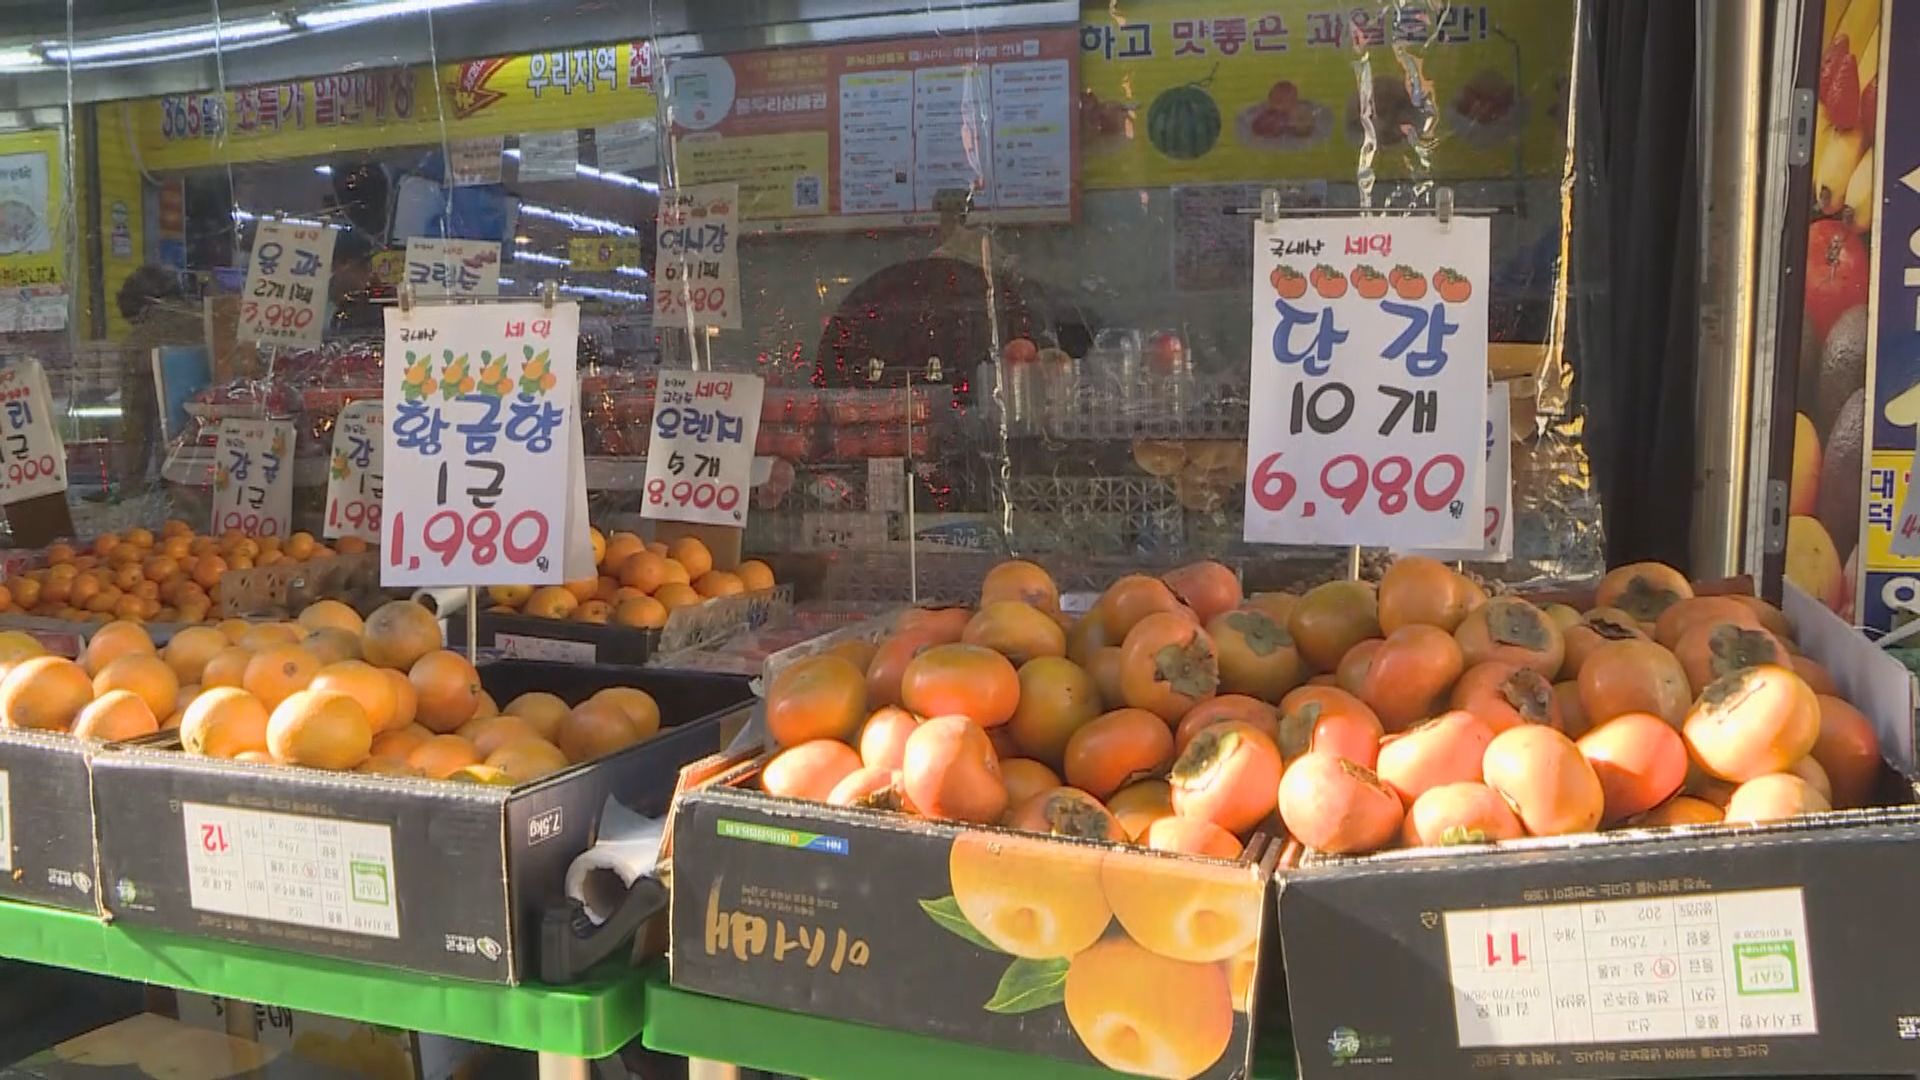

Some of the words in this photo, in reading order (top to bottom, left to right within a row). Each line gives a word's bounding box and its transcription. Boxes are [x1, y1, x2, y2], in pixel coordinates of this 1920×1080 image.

[1172, 15, 1288, 55] 맛좋은
[527, 46, 618, 97] 우리지역
[1270, 237, 1326, 257] 국내산
[392, 393, 565, 456] 황금향
[656, 407, 744, 444] 오렌지
[1290, 381, 1355, 435] 10
[1377, 384, 1438, 437] 개
[329, 498, 383, 532] 1.98
[201, 823, 229, 853] 12
[705, 874, 870, 973] 이서배
[1487, 932, 1527, 967] 11
[1749, 970, 1786, 984] GAP
